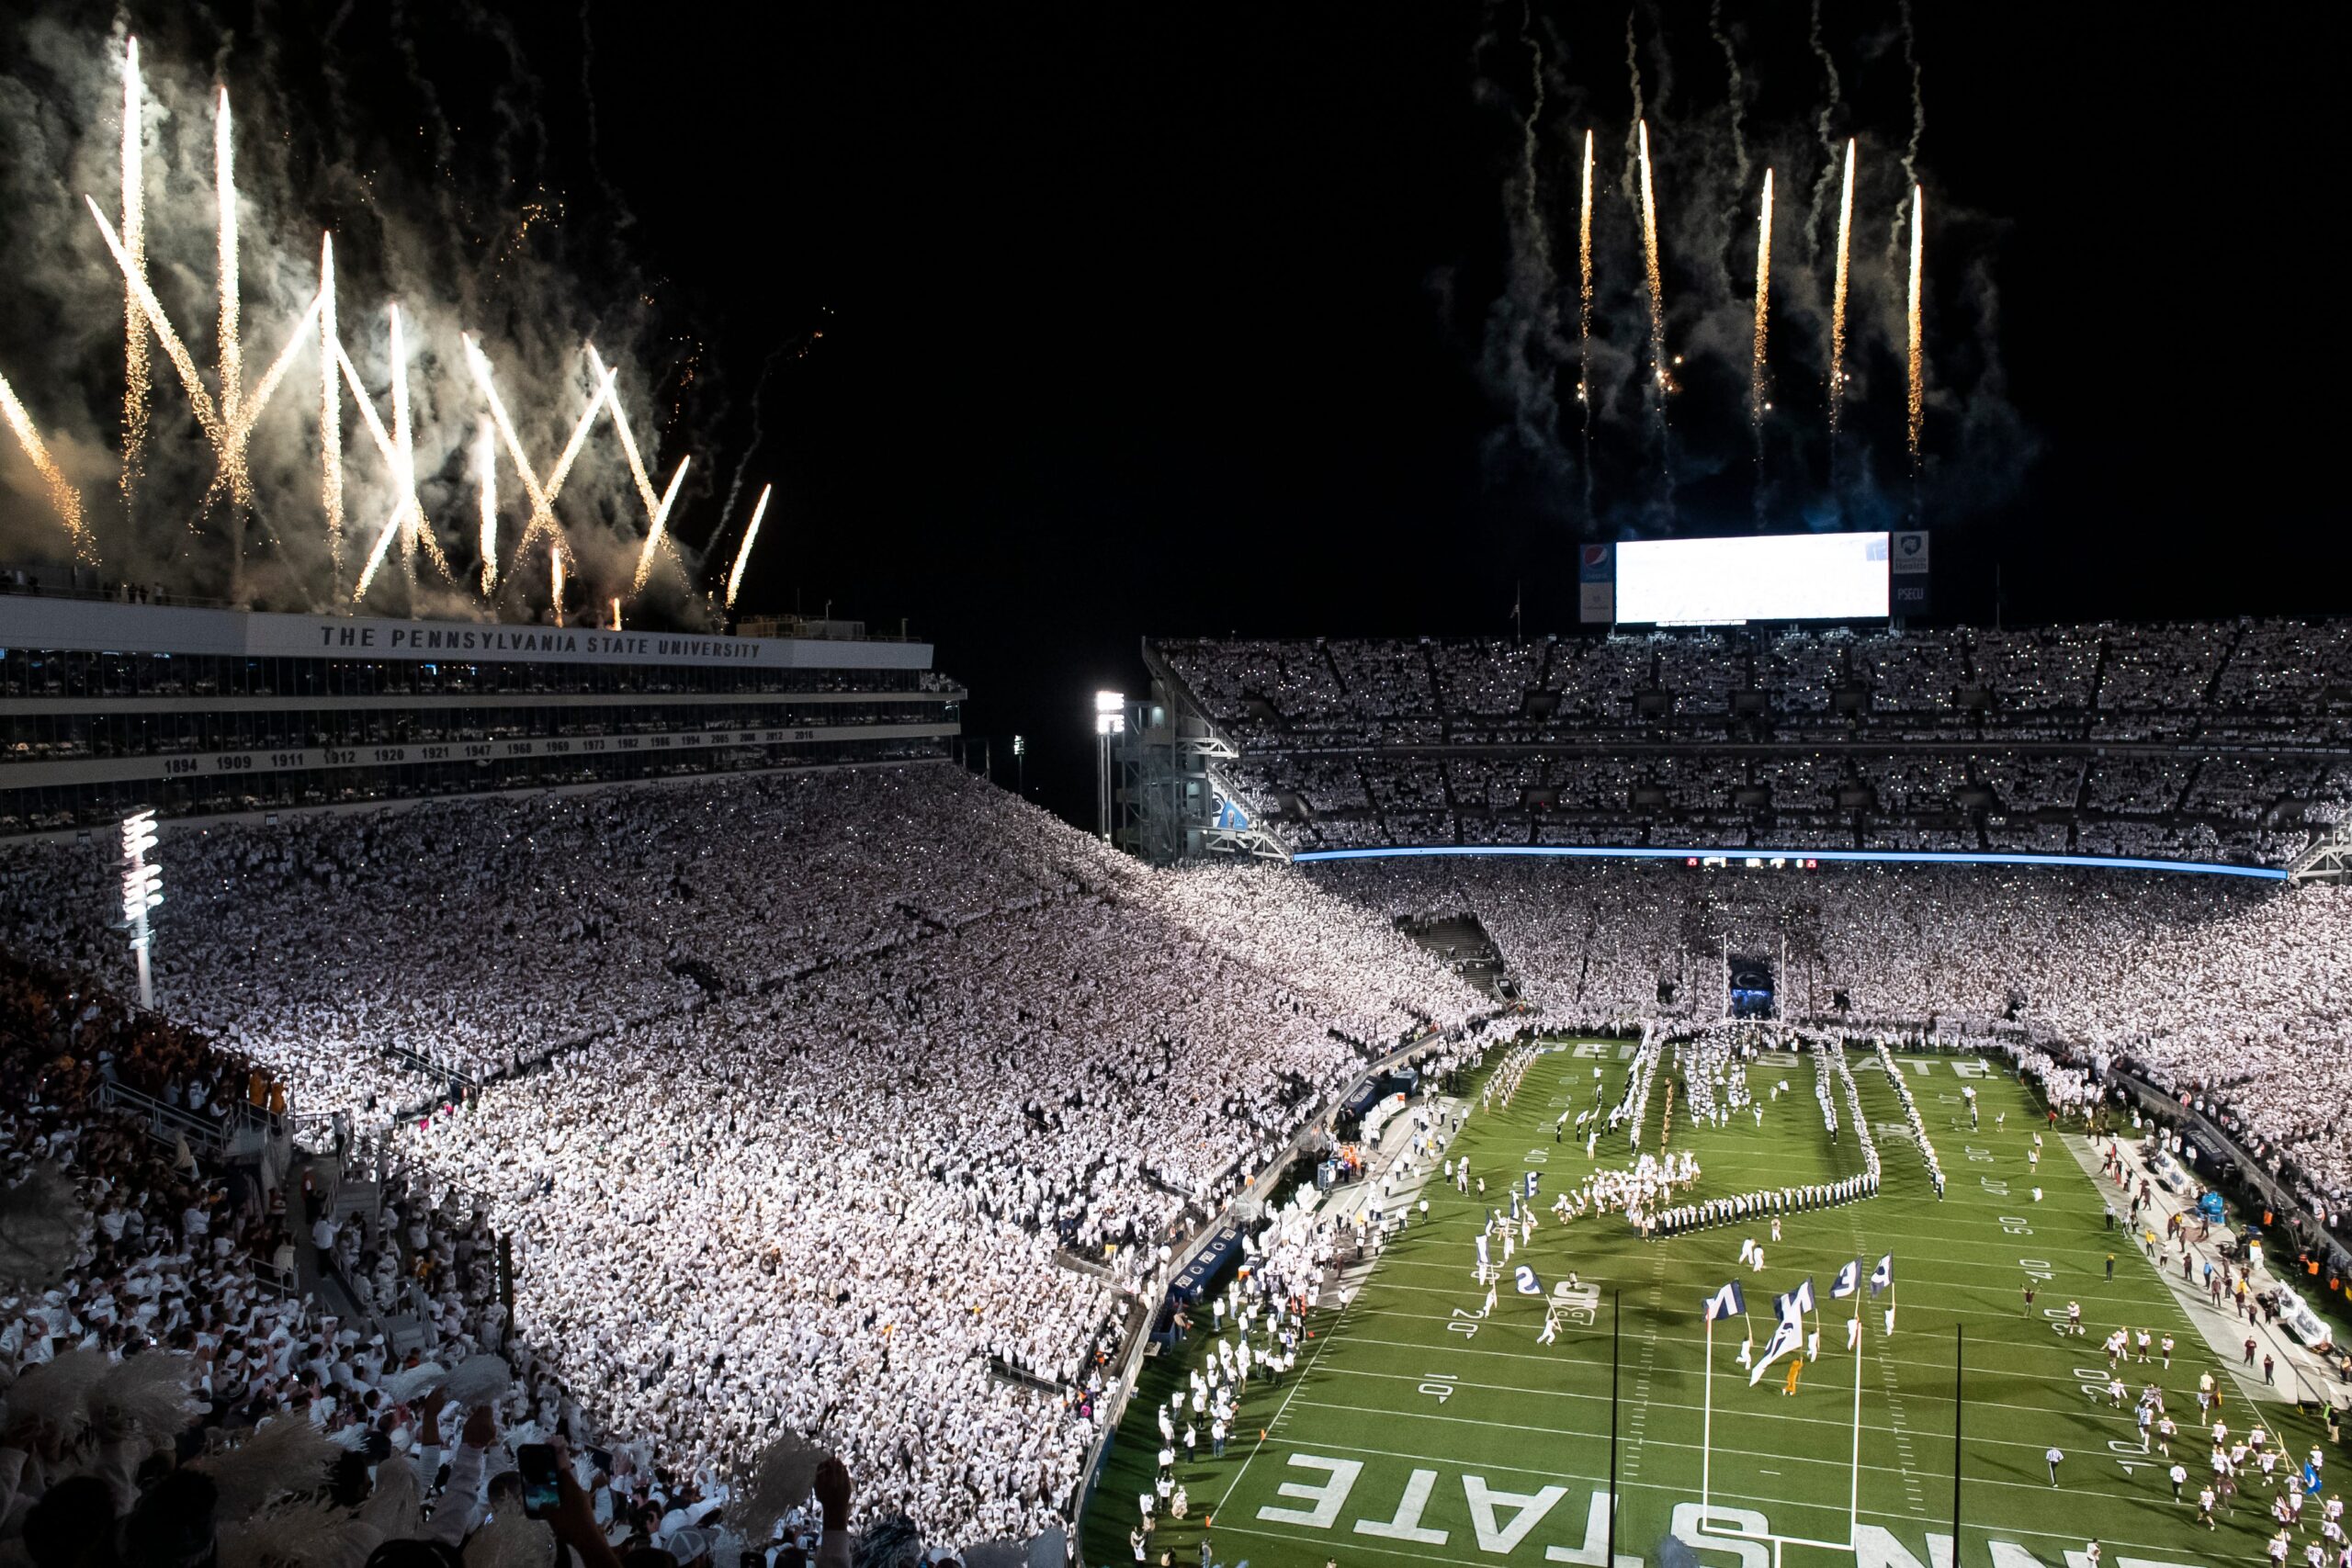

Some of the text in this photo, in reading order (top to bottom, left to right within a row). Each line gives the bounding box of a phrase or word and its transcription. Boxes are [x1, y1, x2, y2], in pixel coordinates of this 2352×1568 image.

[1897, 587, 1924, 600] PSECU
[321, 626, 761, 659] THE PENNSYLVANIA STATE UNIVERSITY
[164, 759, 198, 773] 1894
[216, 755, 252, 770] 1909
[271, 753, 304, 768] 1911
[322, 750, 356, 764] 1912
[374, 749, 404, 761] 1920
[422, 747, 449, 760] 1921
[465, 745, 492, 757] 1947
[507, 743, 532, 754] 1968
[547, 741, 570, 751] 1969
[582, 740, 605, 750] 1973
[617, 738, 639, 749] 1982
[682, 736, 700, 745] 1994
[765, 731, 783, 741] 2012
[1523, 1148, 1549, 1163] 40
[1965, 1147, 1994, 1162] 30
[1981, 1179, 2011, 1196] 40
[1999, 1216, 2033, 1235] 50
[2018, 1259, 2056, 1280] 40
[1447, 1308, 1485, 1333] 20
[1418, 1373, 1458, 1396] 10
[2073, 1368, 2112, 1395] 20
[2108, 1440, 2158, 1467] 10
[1256, 1453, 1770, 1568] STATE
